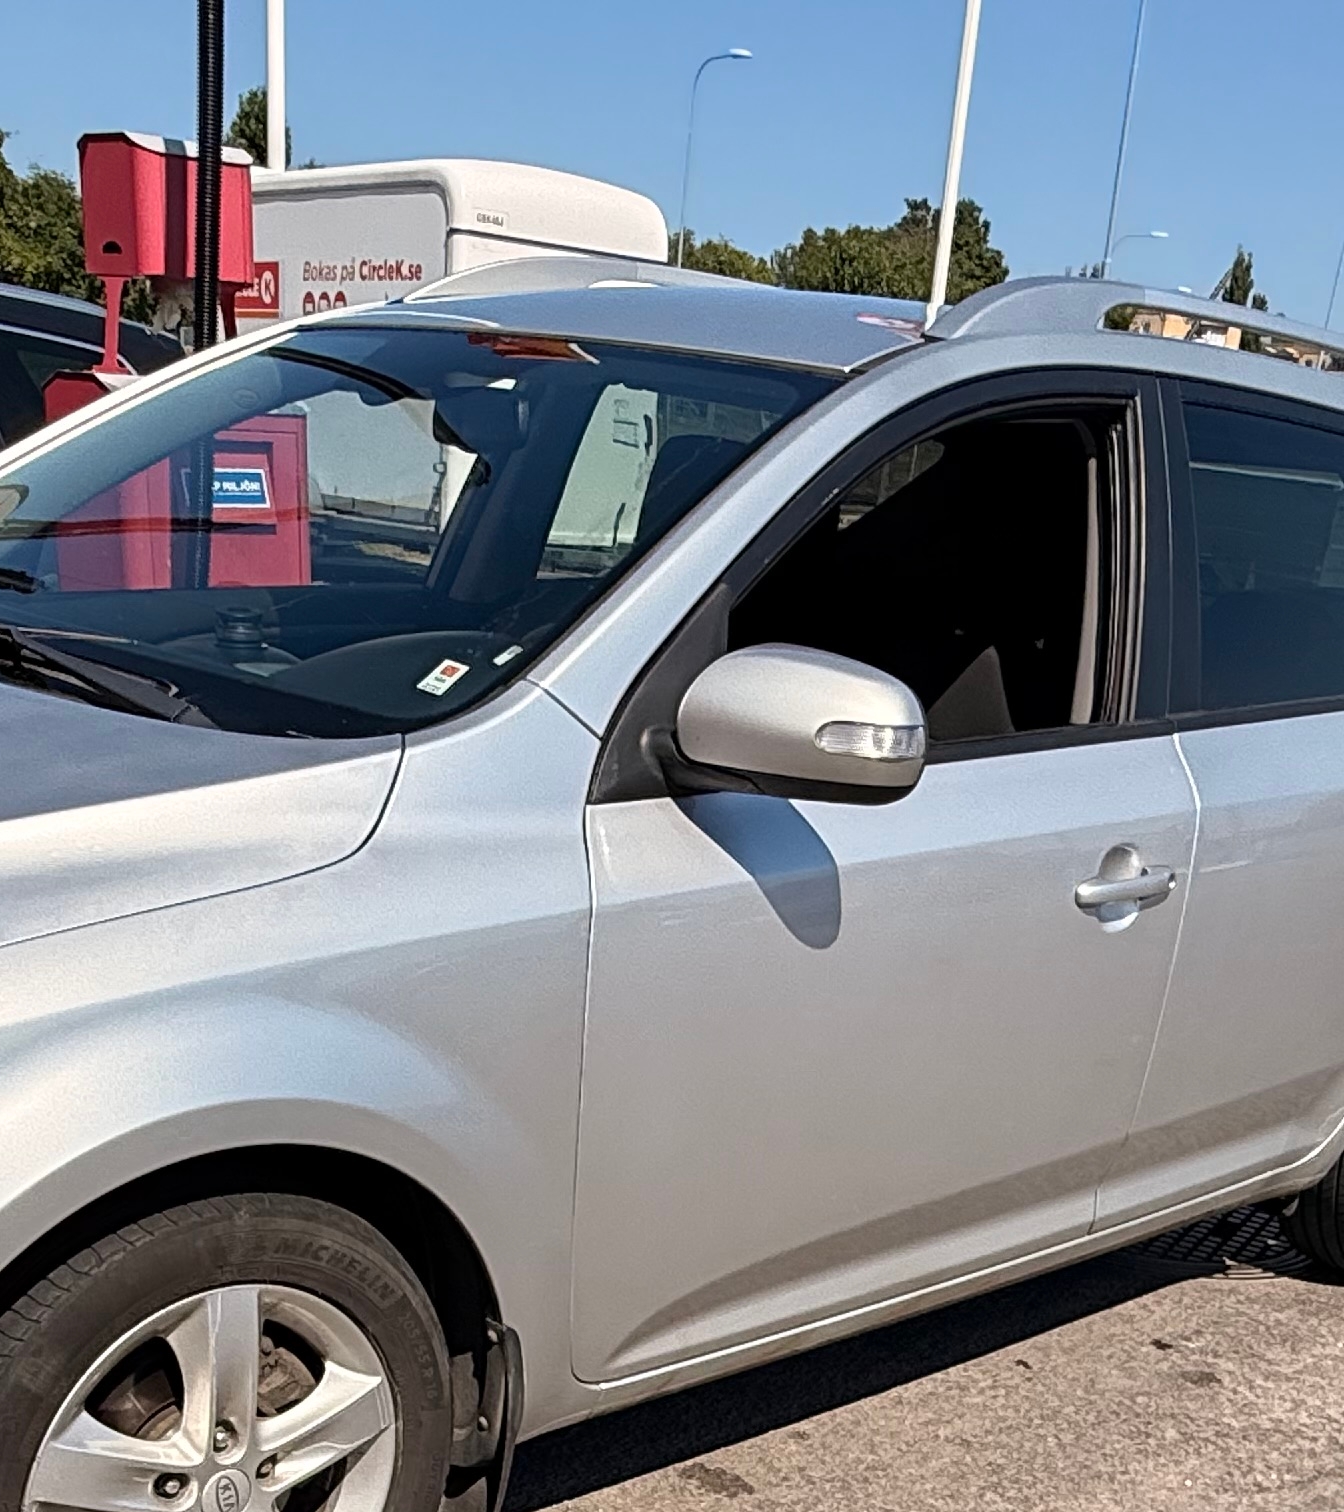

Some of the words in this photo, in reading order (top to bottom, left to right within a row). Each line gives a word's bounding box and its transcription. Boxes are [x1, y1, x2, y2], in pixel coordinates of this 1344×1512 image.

[302, 260, 338, 282] Bokas
[340, 257, 355, 285] på
[358, 260, 422, 282] CircleK.se
[274, 1236, 396, 1301] MICHELIN
